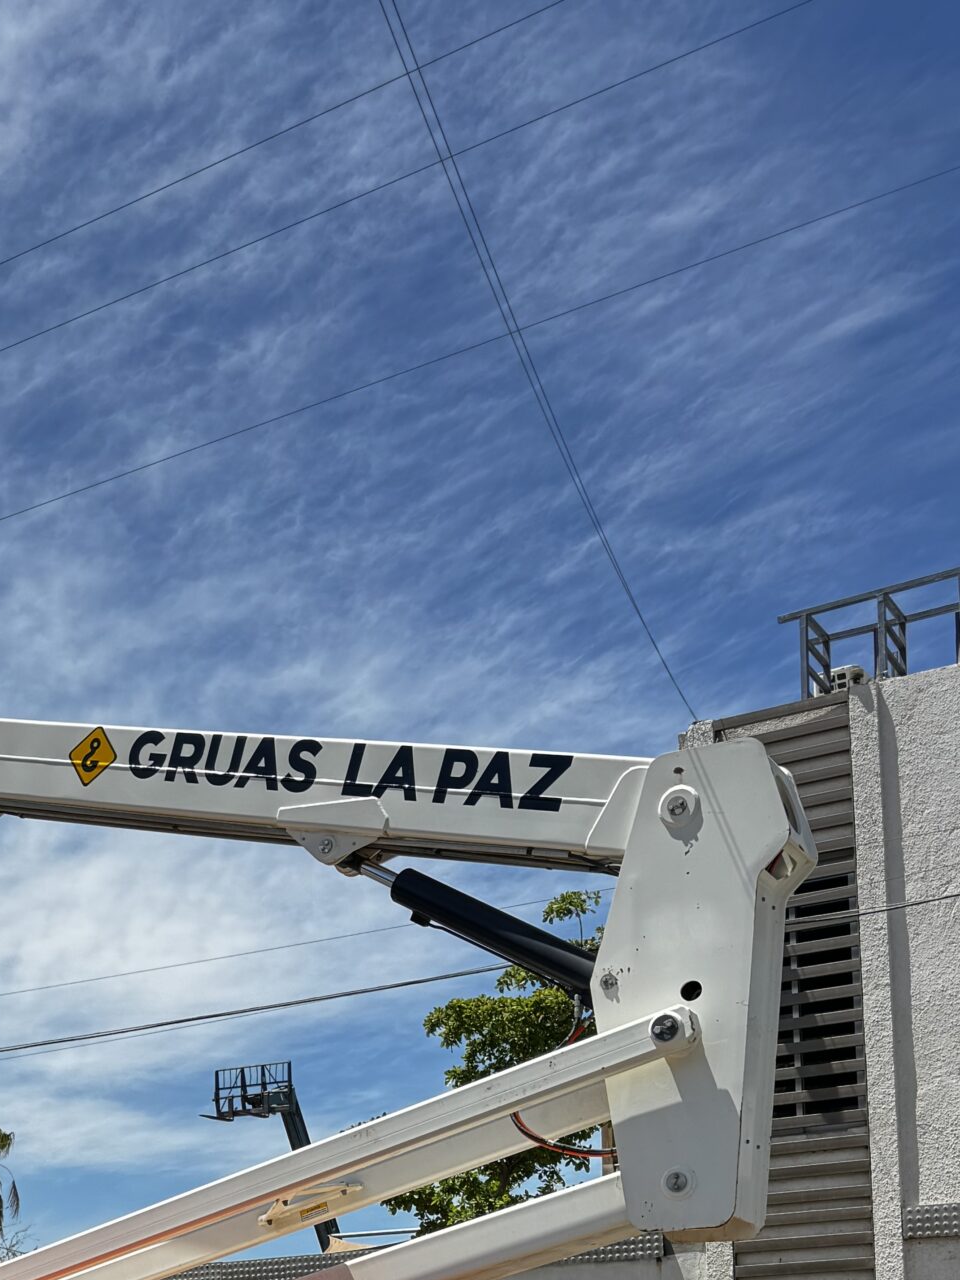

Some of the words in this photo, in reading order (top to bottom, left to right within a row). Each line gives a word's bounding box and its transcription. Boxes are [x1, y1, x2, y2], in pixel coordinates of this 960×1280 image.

[129, 730, 323, 793] GRUAS
[341, 743, 417, 801] LA
[432, 748, 573, 812] PAZ
